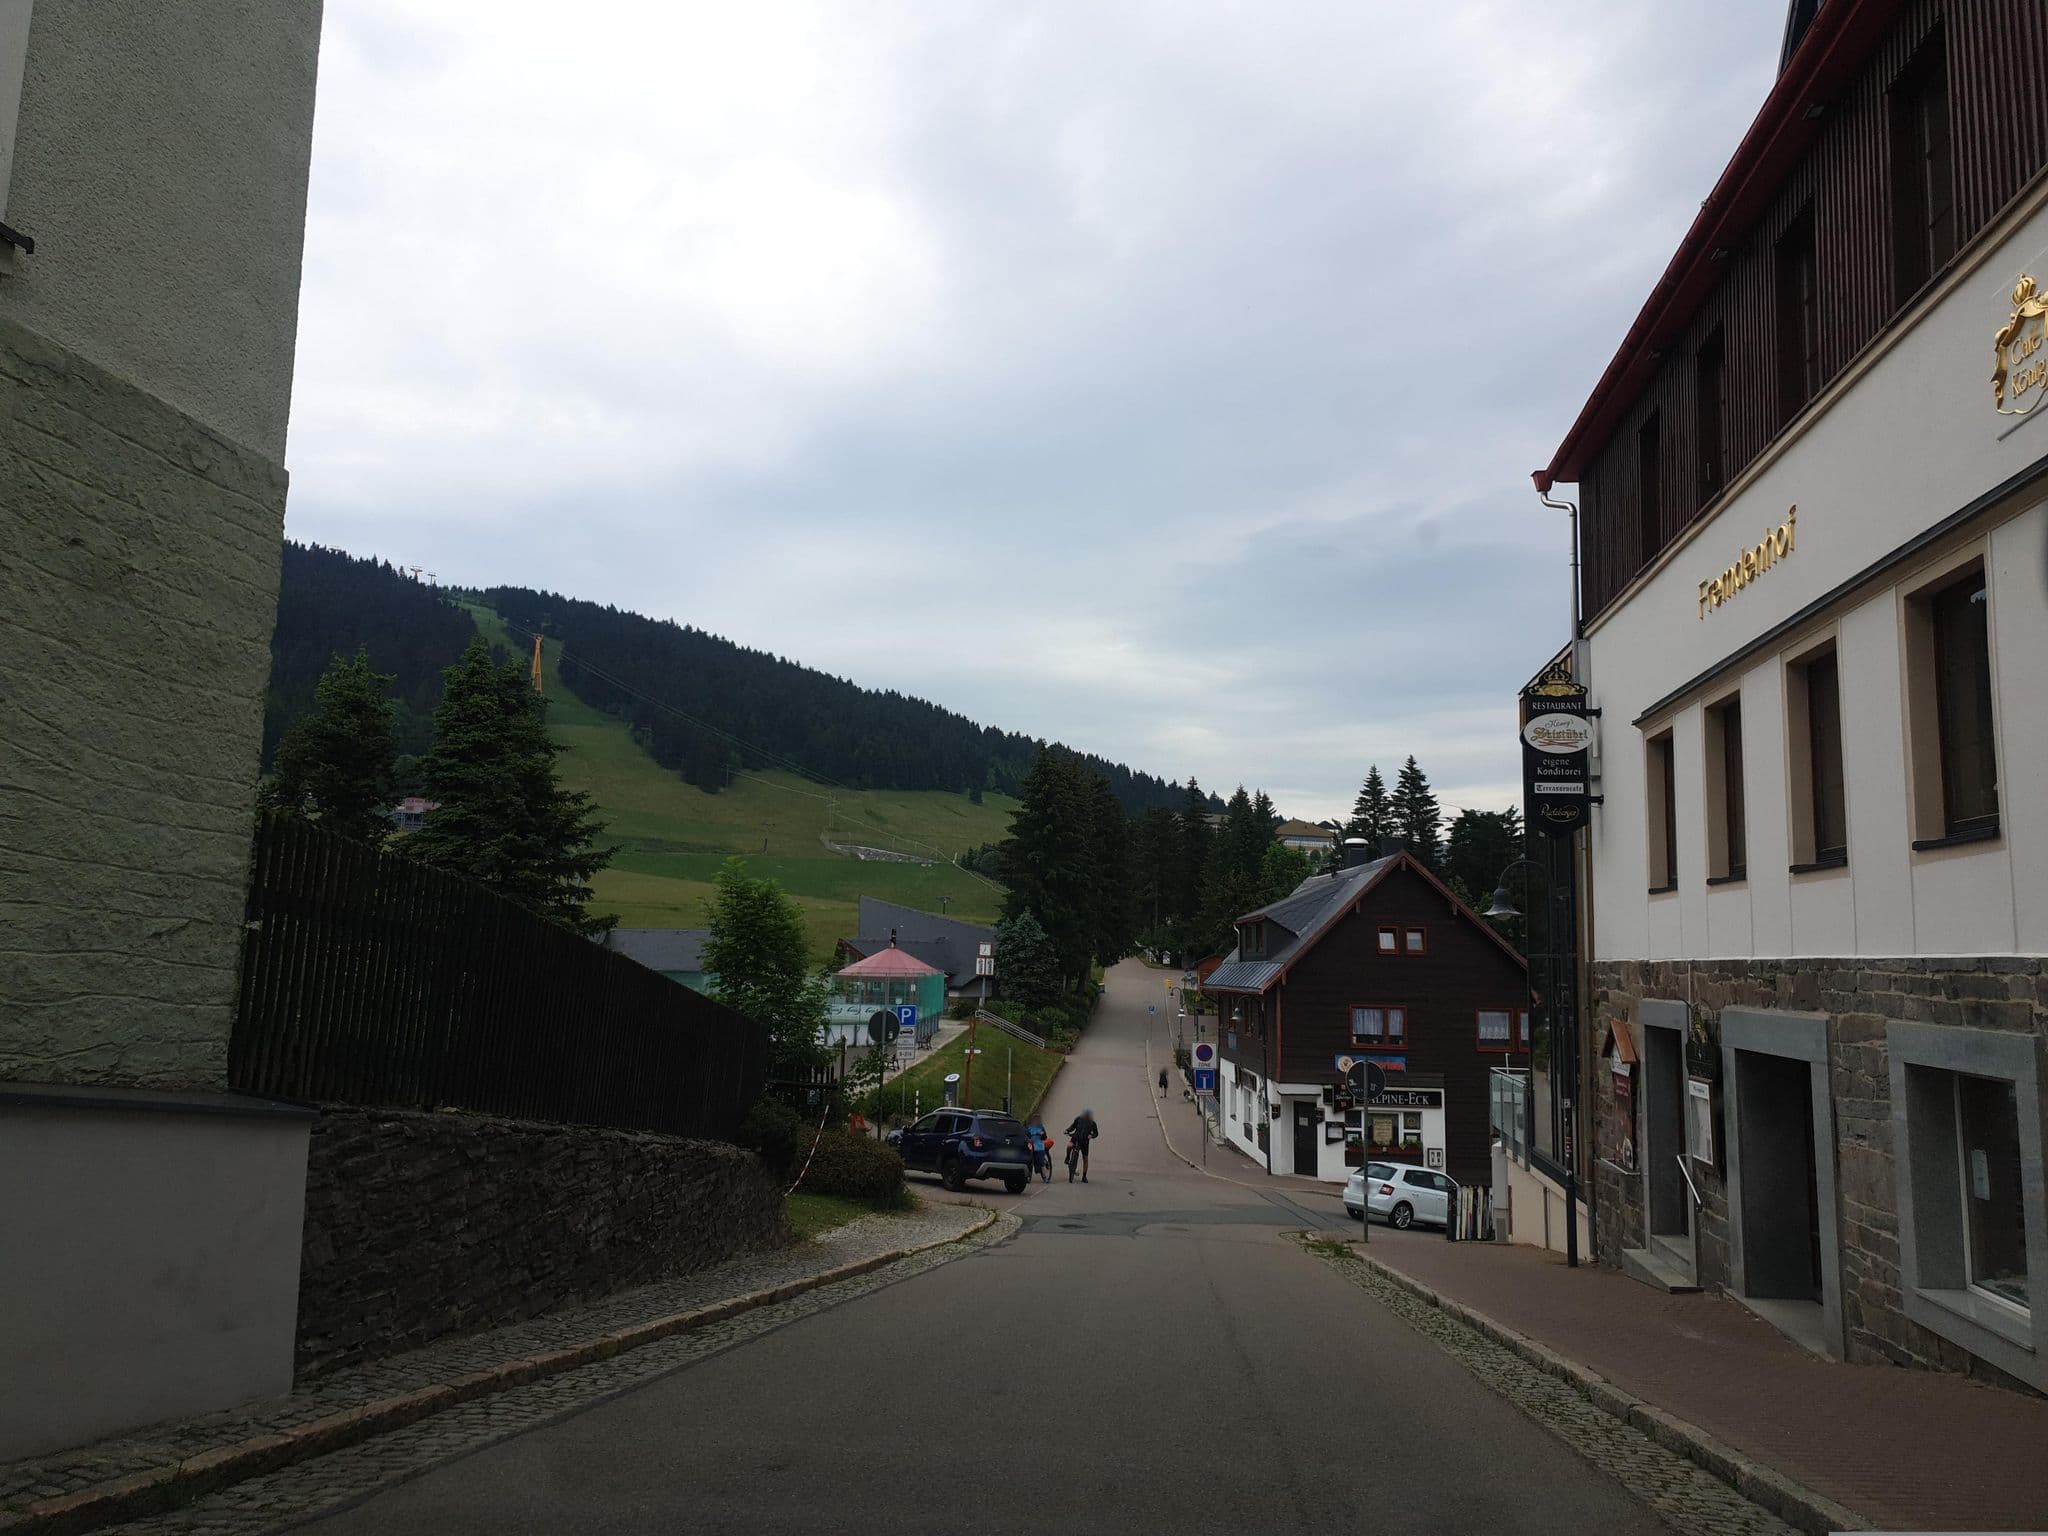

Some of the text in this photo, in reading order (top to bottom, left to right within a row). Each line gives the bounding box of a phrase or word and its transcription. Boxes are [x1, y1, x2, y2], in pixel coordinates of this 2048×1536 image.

[1532, 701, 1582, 711] RESTAURANT
[1542, 758, 1571, 768] eigene
[1537, 767, 1582, 777] Konditorei
[901, 1007, 912, 1024] P
